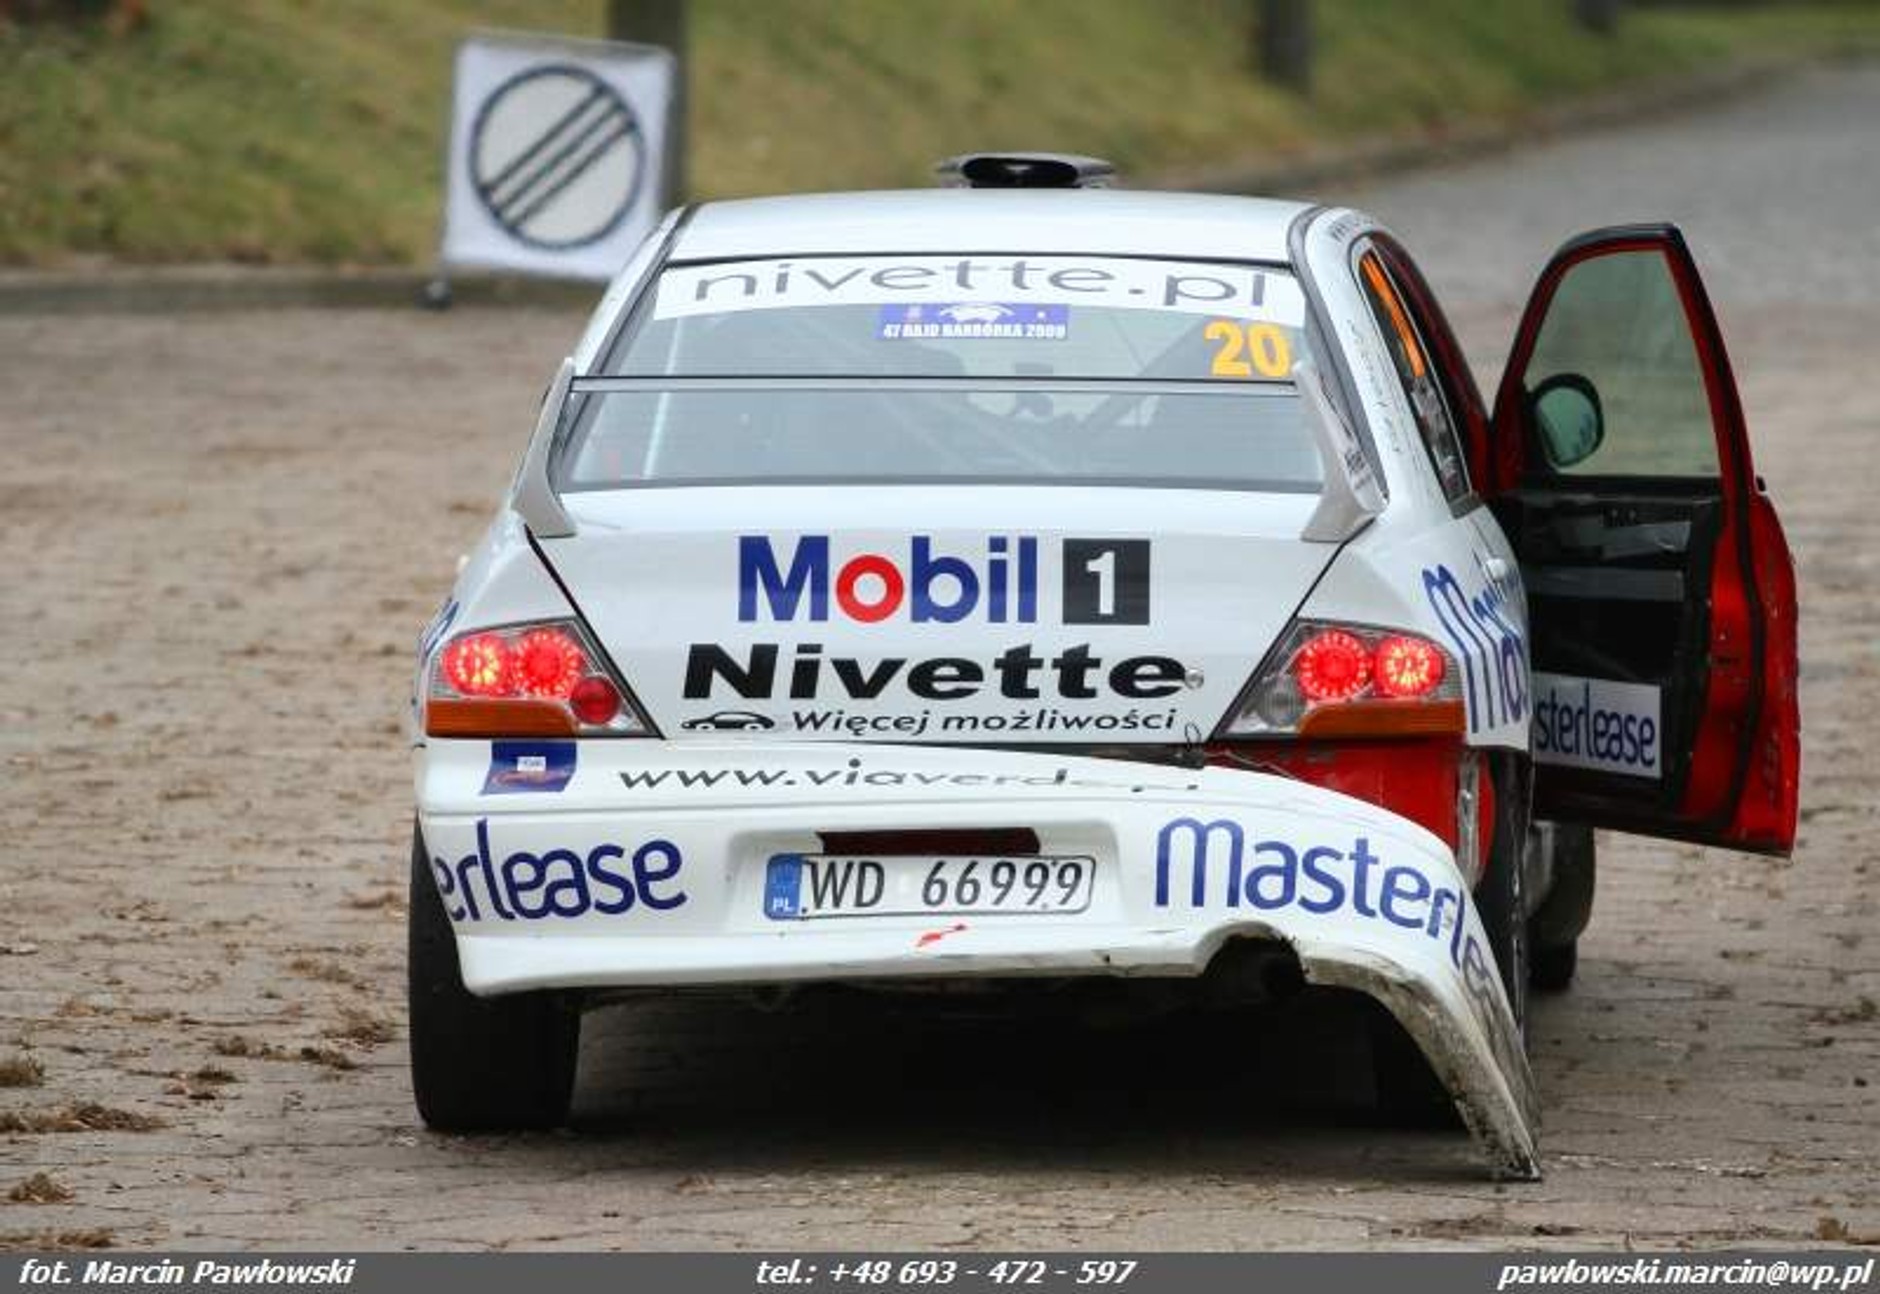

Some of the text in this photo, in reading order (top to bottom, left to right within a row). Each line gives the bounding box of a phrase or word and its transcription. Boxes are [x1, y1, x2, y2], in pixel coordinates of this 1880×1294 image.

[695, 260, 1266, 306] nivette.pl
[1204, 321, 1291, 378] 20
[738, 535, 1114, 624] Mobil 1
[682, 643, 1186, 701] Nivette
[792, 707, 1176, 736] Więcej możliwości
[808, 860, 885, 910] WD
[921, 860, 1084, 907] 66999
